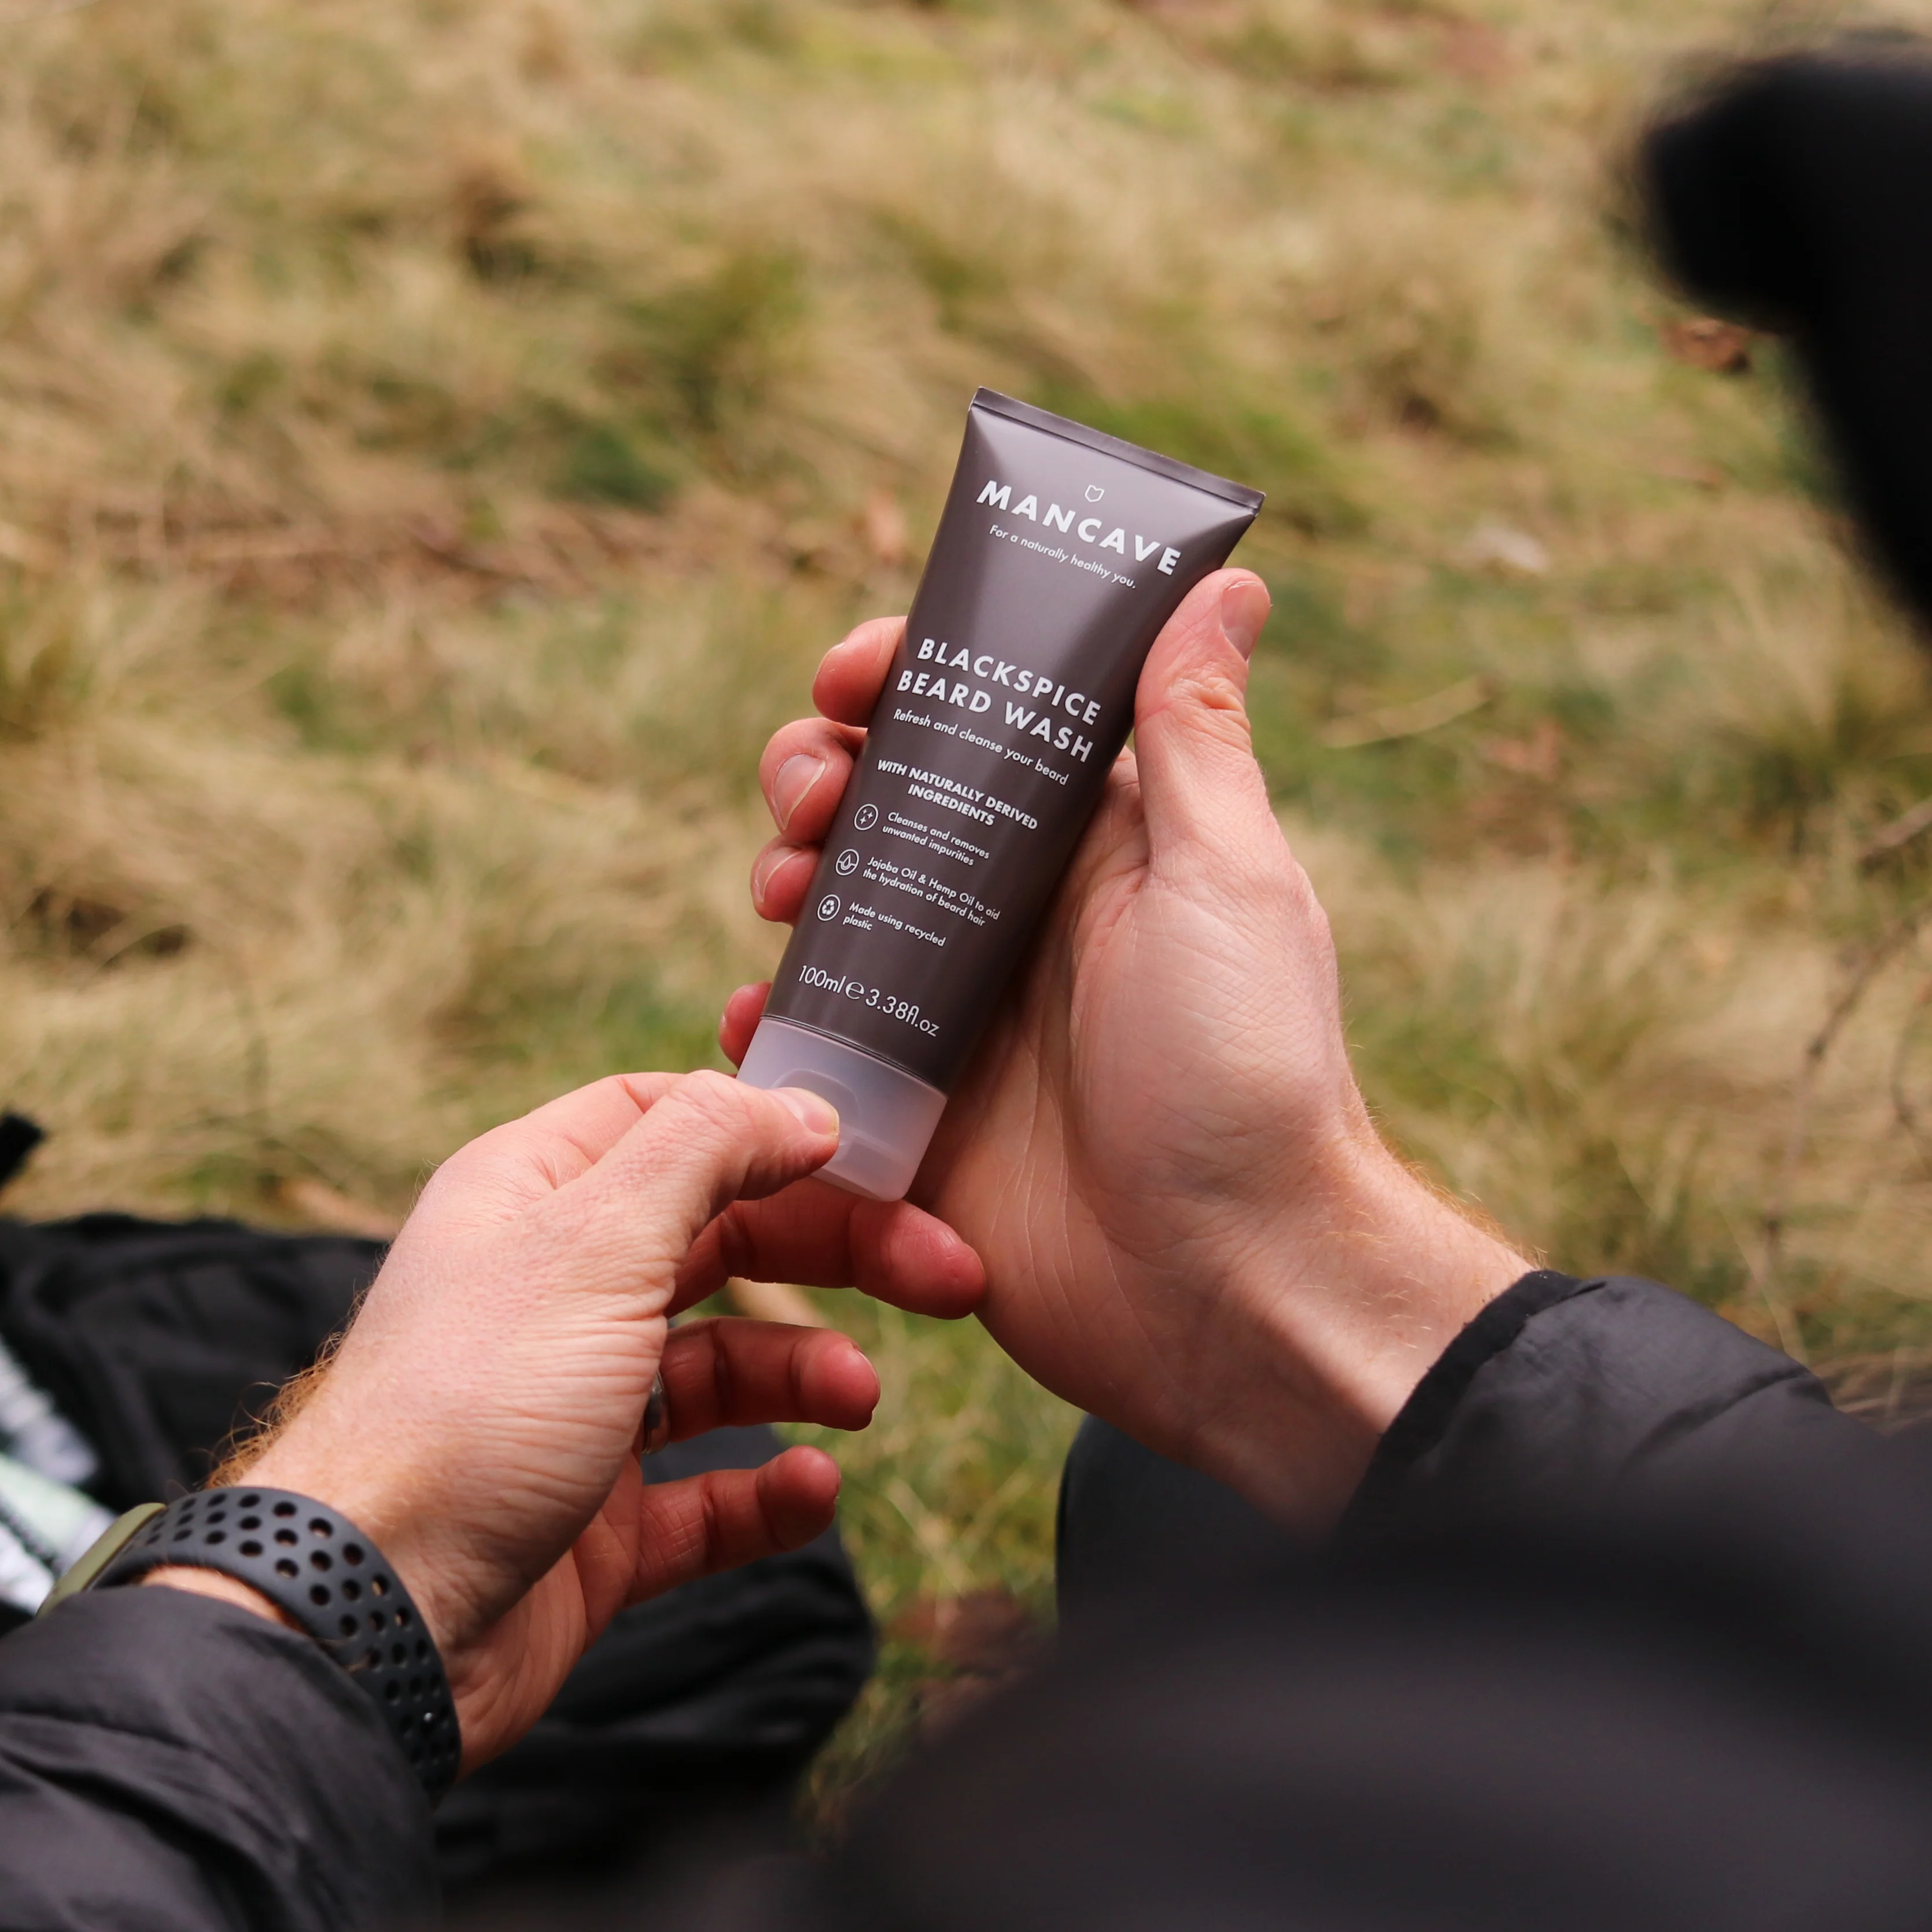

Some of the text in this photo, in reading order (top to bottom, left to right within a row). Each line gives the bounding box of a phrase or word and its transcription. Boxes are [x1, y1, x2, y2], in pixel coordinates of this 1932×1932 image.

[976, 480, 1181, 576] MANCAVE
[990, 524, 1136, 589] For a naturally healthy you.
[917, 638, 1101, 725] BLACKSPICE
[893, 708, 1069, 786] Refresh and cleanse your beard
[897, 670, 1093, 762] BEARD WASH
[877, 759, 1038, 830] WITH NATURALLY DERIVED
[908, 784, 995, 826] INGREDIENTS
[882, 825, 974, 866] unwanted impurities
[888, 812, 990, 859] Cleanses and removes
[862, 868, 986, 926] the hydration of beard hair
[867, 857, 1001, 920] Jojoba Oil & Hemp Oil to aid
[842, 915, 872, 931] plastic
[849, 902, 946, 947] Made using recycled
